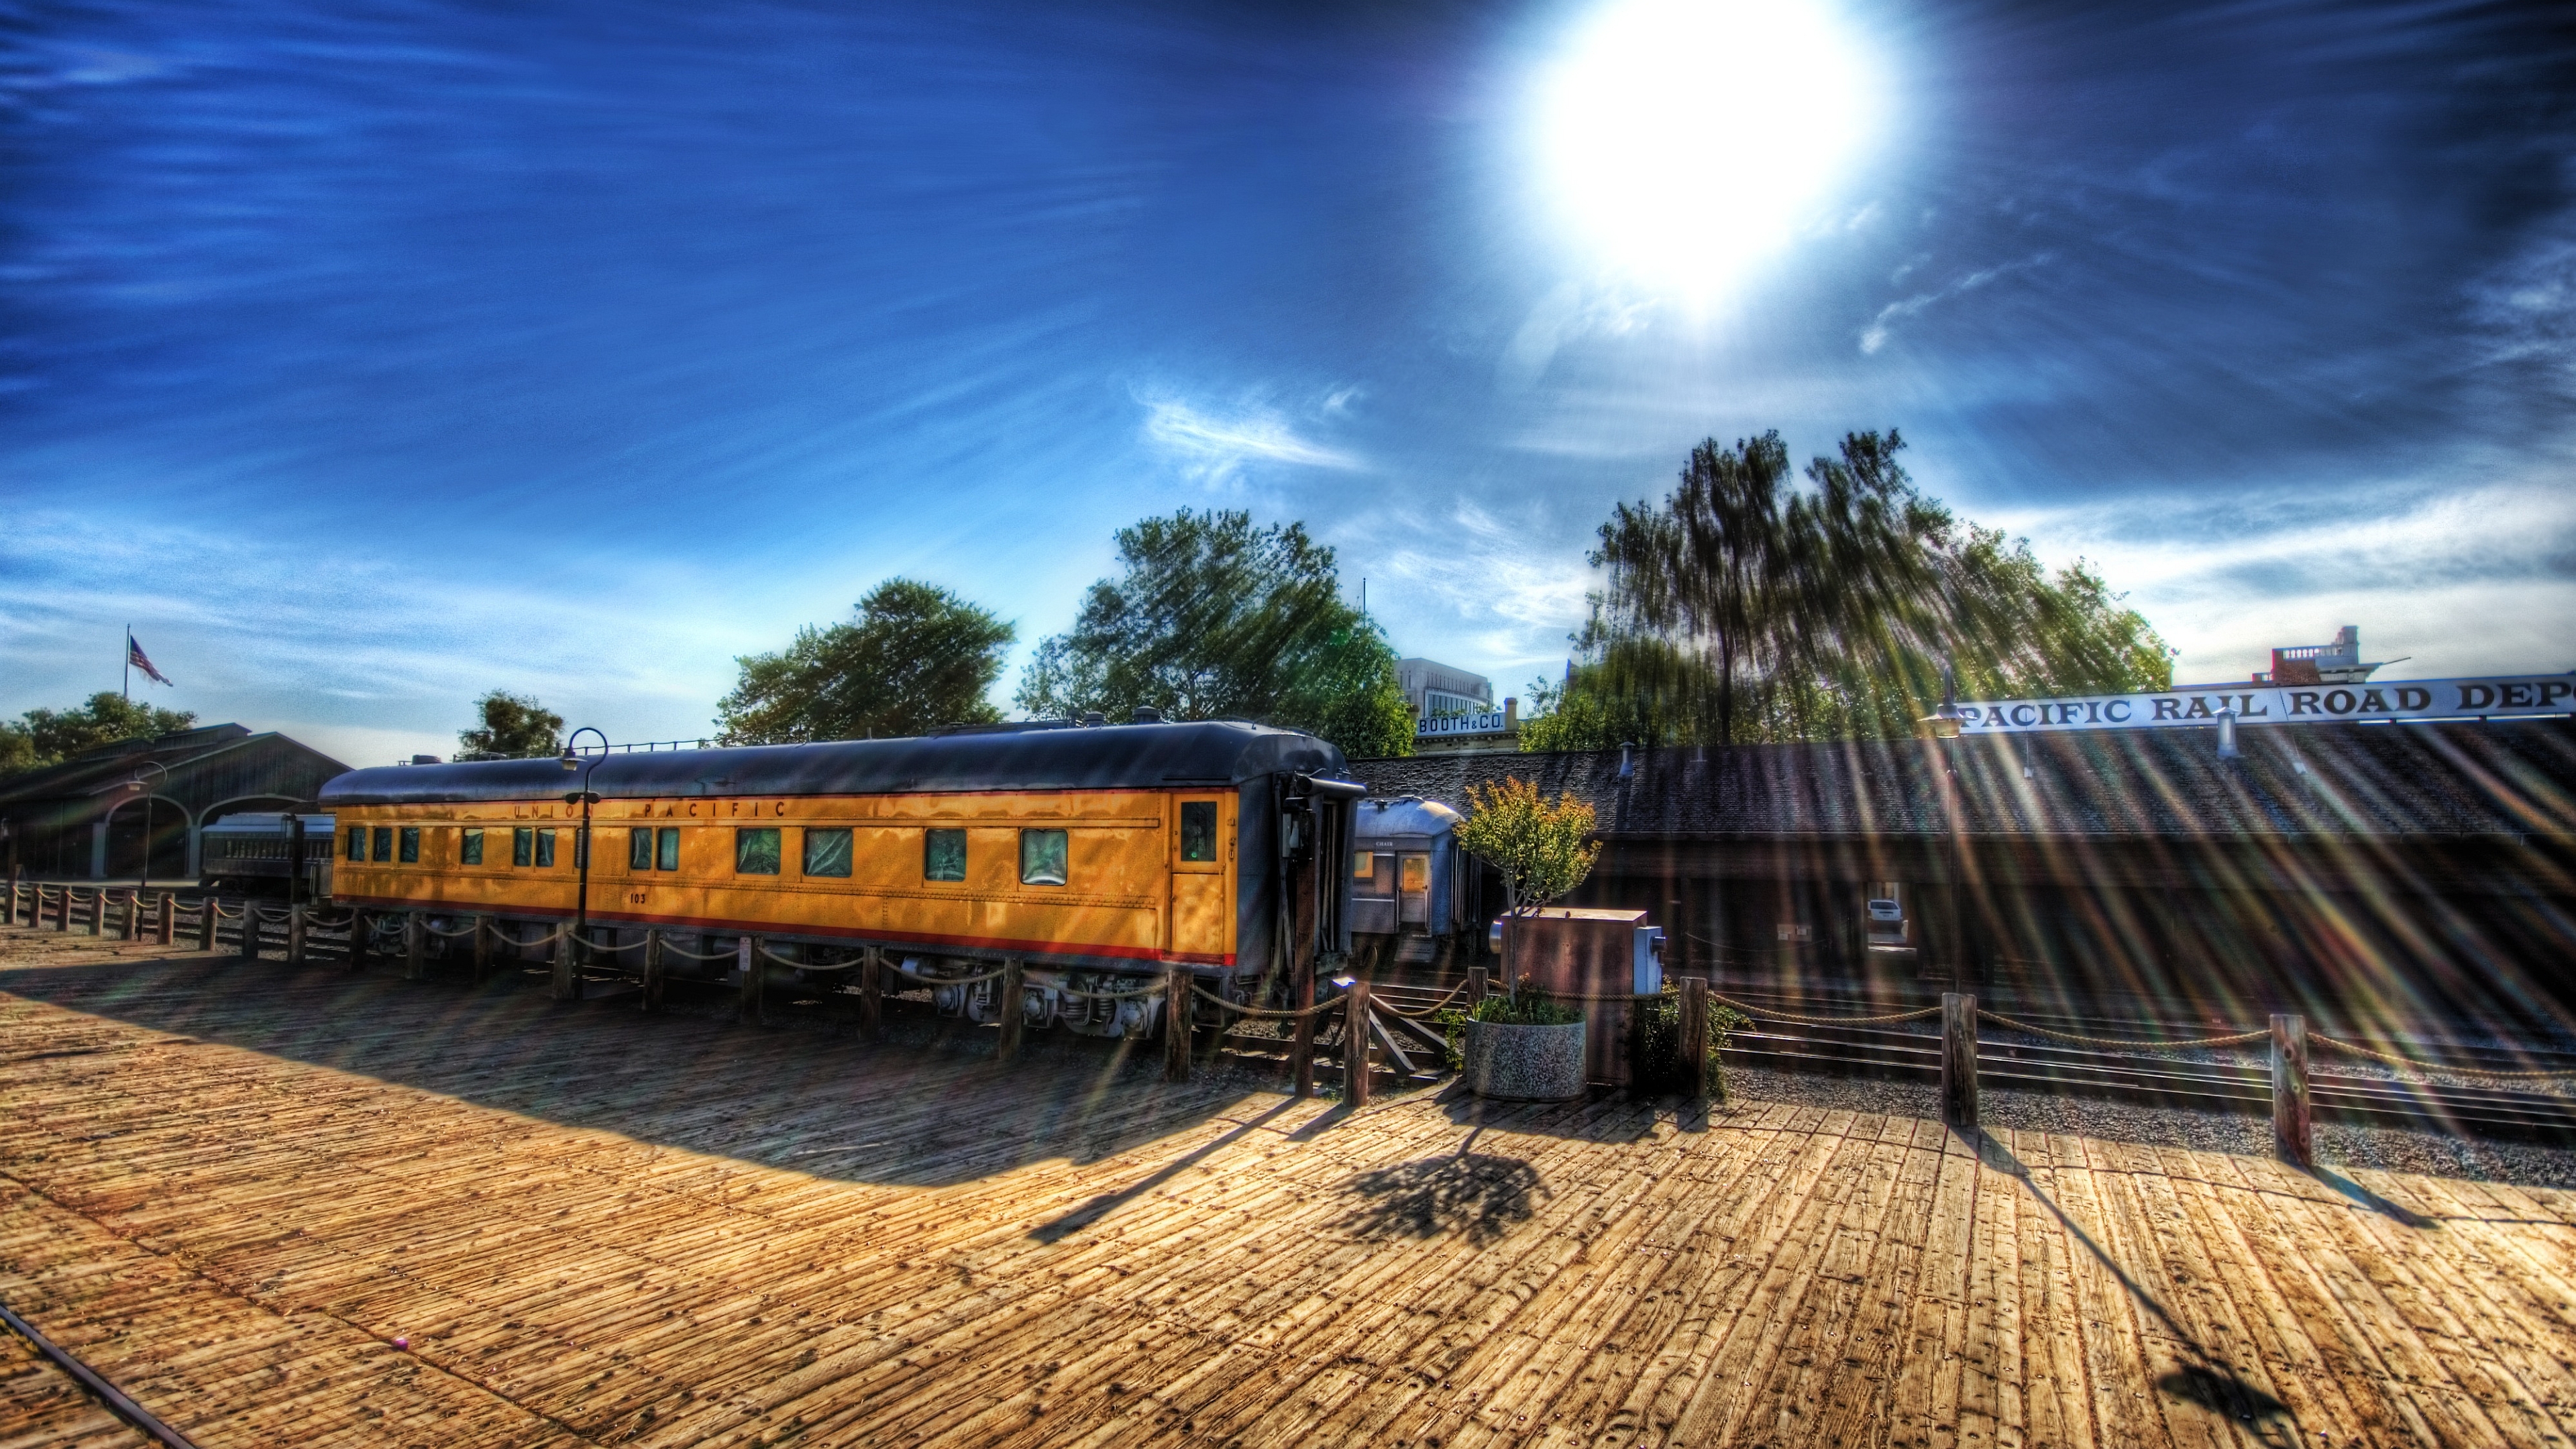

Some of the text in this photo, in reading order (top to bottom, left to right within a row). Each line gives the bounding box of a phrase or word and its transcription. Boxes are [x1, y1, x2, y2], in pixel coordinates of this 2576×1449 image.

[1957, 700, 2131, 727] PACIFIC
[2288, 688, 2431, 715] ROAD
[2457, 682, 2576, 710] DEP
[645, 802, 784, 817] PACIFIC
[631, 894, 645, 904] 103
